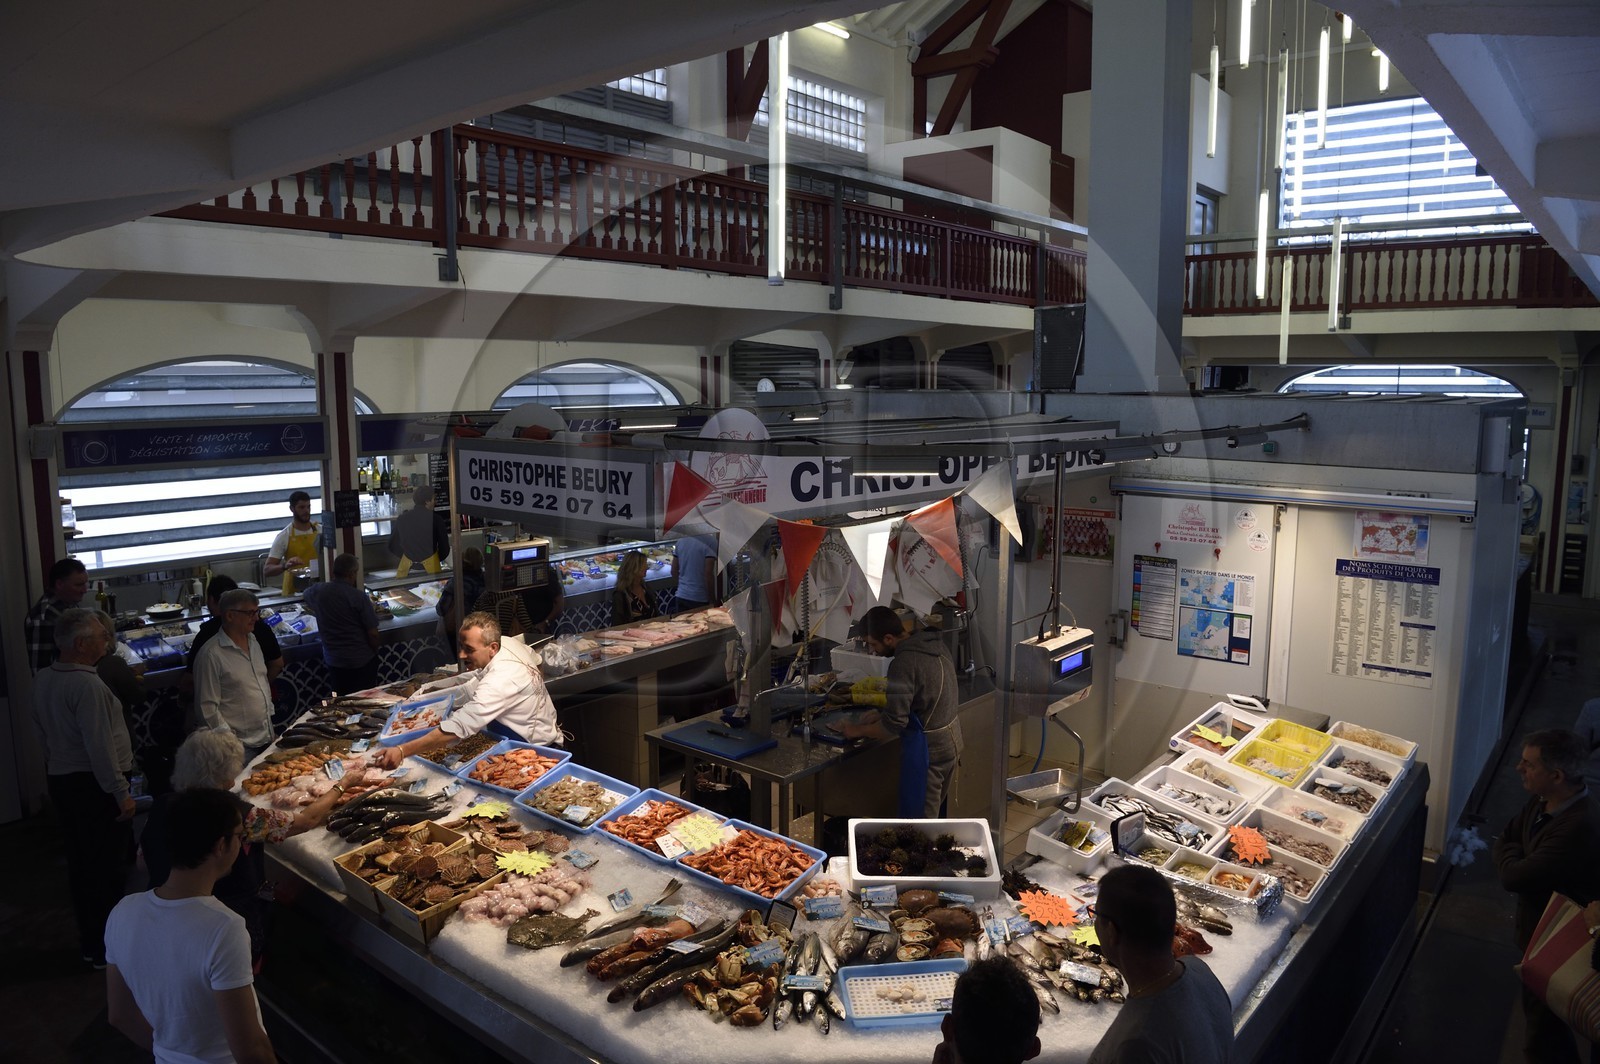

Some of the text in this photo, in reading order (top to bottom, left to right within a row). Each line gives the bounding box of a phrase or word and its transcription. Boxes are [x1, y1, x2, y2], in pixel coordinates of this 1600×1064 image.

[149, 435, 183, 445] VENTE
[197, 431, 252, 443] EMPORTER
[213, 443, 237, 453] SUR
[240, 442, 271, 452] PLACE
[468, 457, 566, 489] CHRISTOPHE
[572, 466, 633, 496] BEURY
[791, 453, 1018, 502] CHROP
[470, 485, 633, 520] 05 59 22 07 64
[1168, 523, 1197, 532] Christophe
[1349, 560, 1427, 573] NOMS SCIENTIFIQUES
[1357, 566, 1393, 576] PRODUITS
